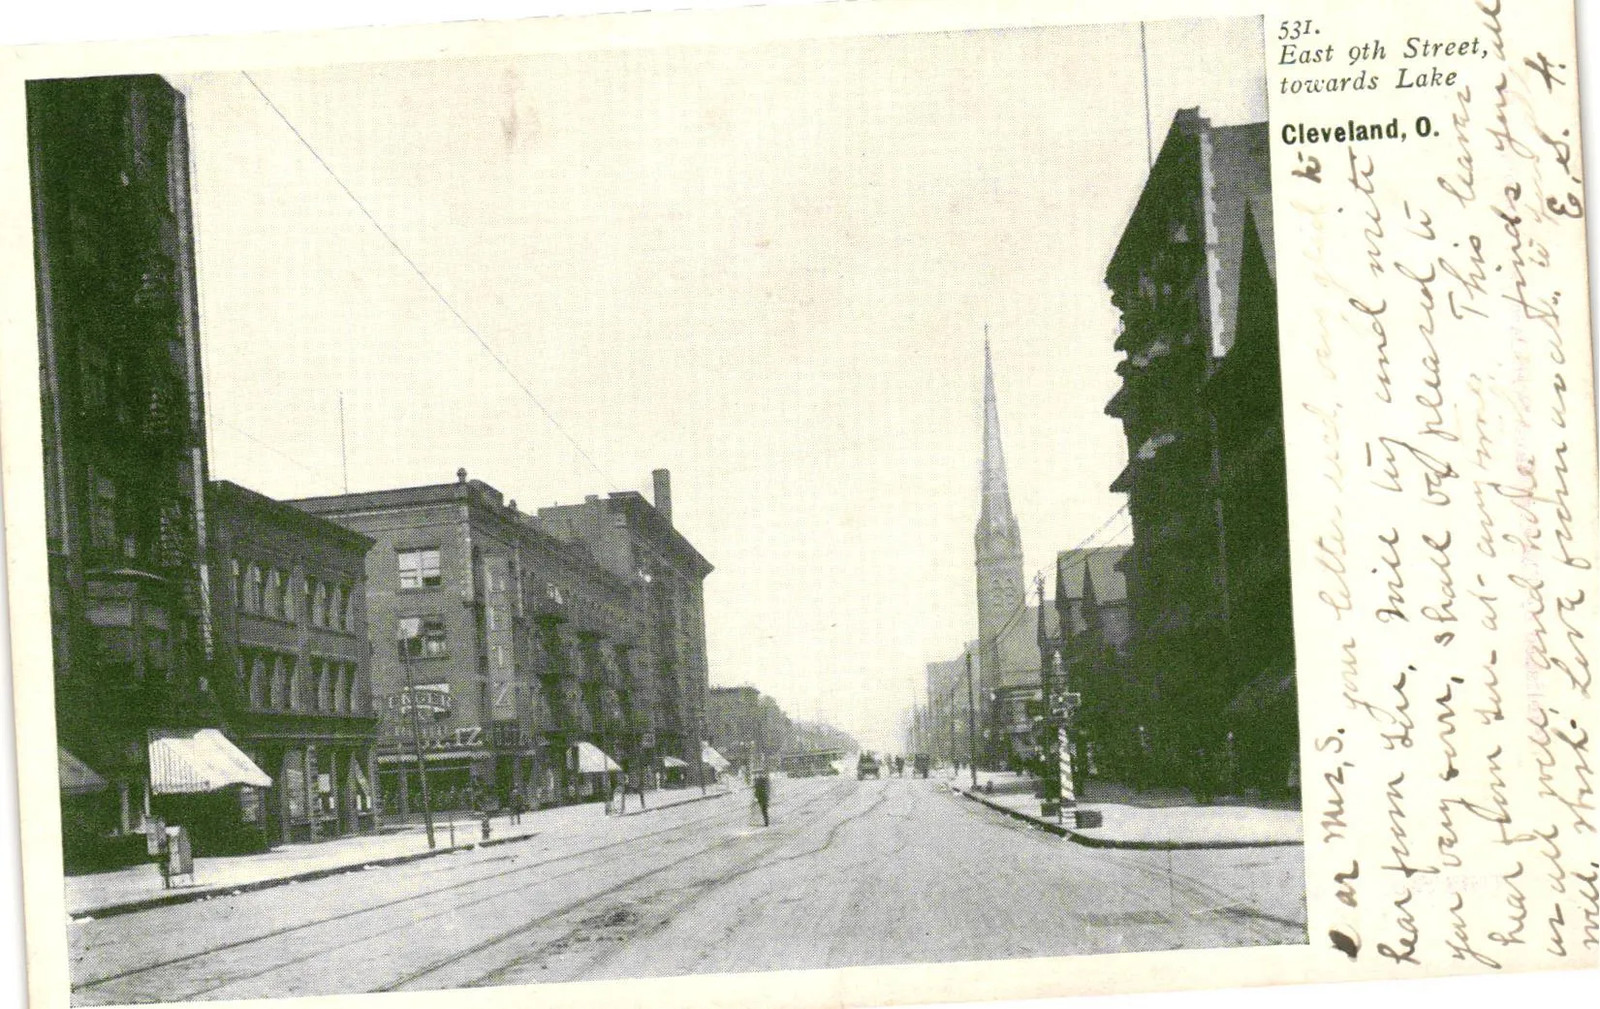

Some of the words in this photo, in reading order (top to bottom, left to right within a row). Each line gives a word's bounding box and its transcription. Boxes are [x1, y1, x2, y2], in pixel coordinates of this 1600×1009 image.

[1278, 20, 1321, 40] 531.
[1278, 44, 1334, 65] East
[1348, 39, 1387, 65] 9th
[1403, 37, 1488, 59] Street,
[1280, 71, 1379, 94] towards
[1395, 67, 1458, 89] Lake
[1486, 72, 1531, 159] you
[1281, 118, 1407, 145] Cleveland,
[1415, 116, 1440, 137] O.
[1436, 85, 1477, 208] leaves
[1338, 146, 1384, 277] write
[1404, 200, 1436, 240] to
[1437, 234, 1489, 319] This
[1349, 299, 1392, 403] and
[1394, 262, 1459, 441] pleased
[1549, 442, 1591, 570] from
[1421, 530, 1458, 646] shall
[1468, 573, 1498, 630] at
[1508, 573, 1552, 670] and
[1552, 589, 1591, 698] Love
[1381, 773, 1439, 877] from
[1487, 745, 1536, 845] from
[1532, 825, 1565, 893] all
[1377, 890, 1421, 965] hear
[1488, 862, 1526, 946] hear
